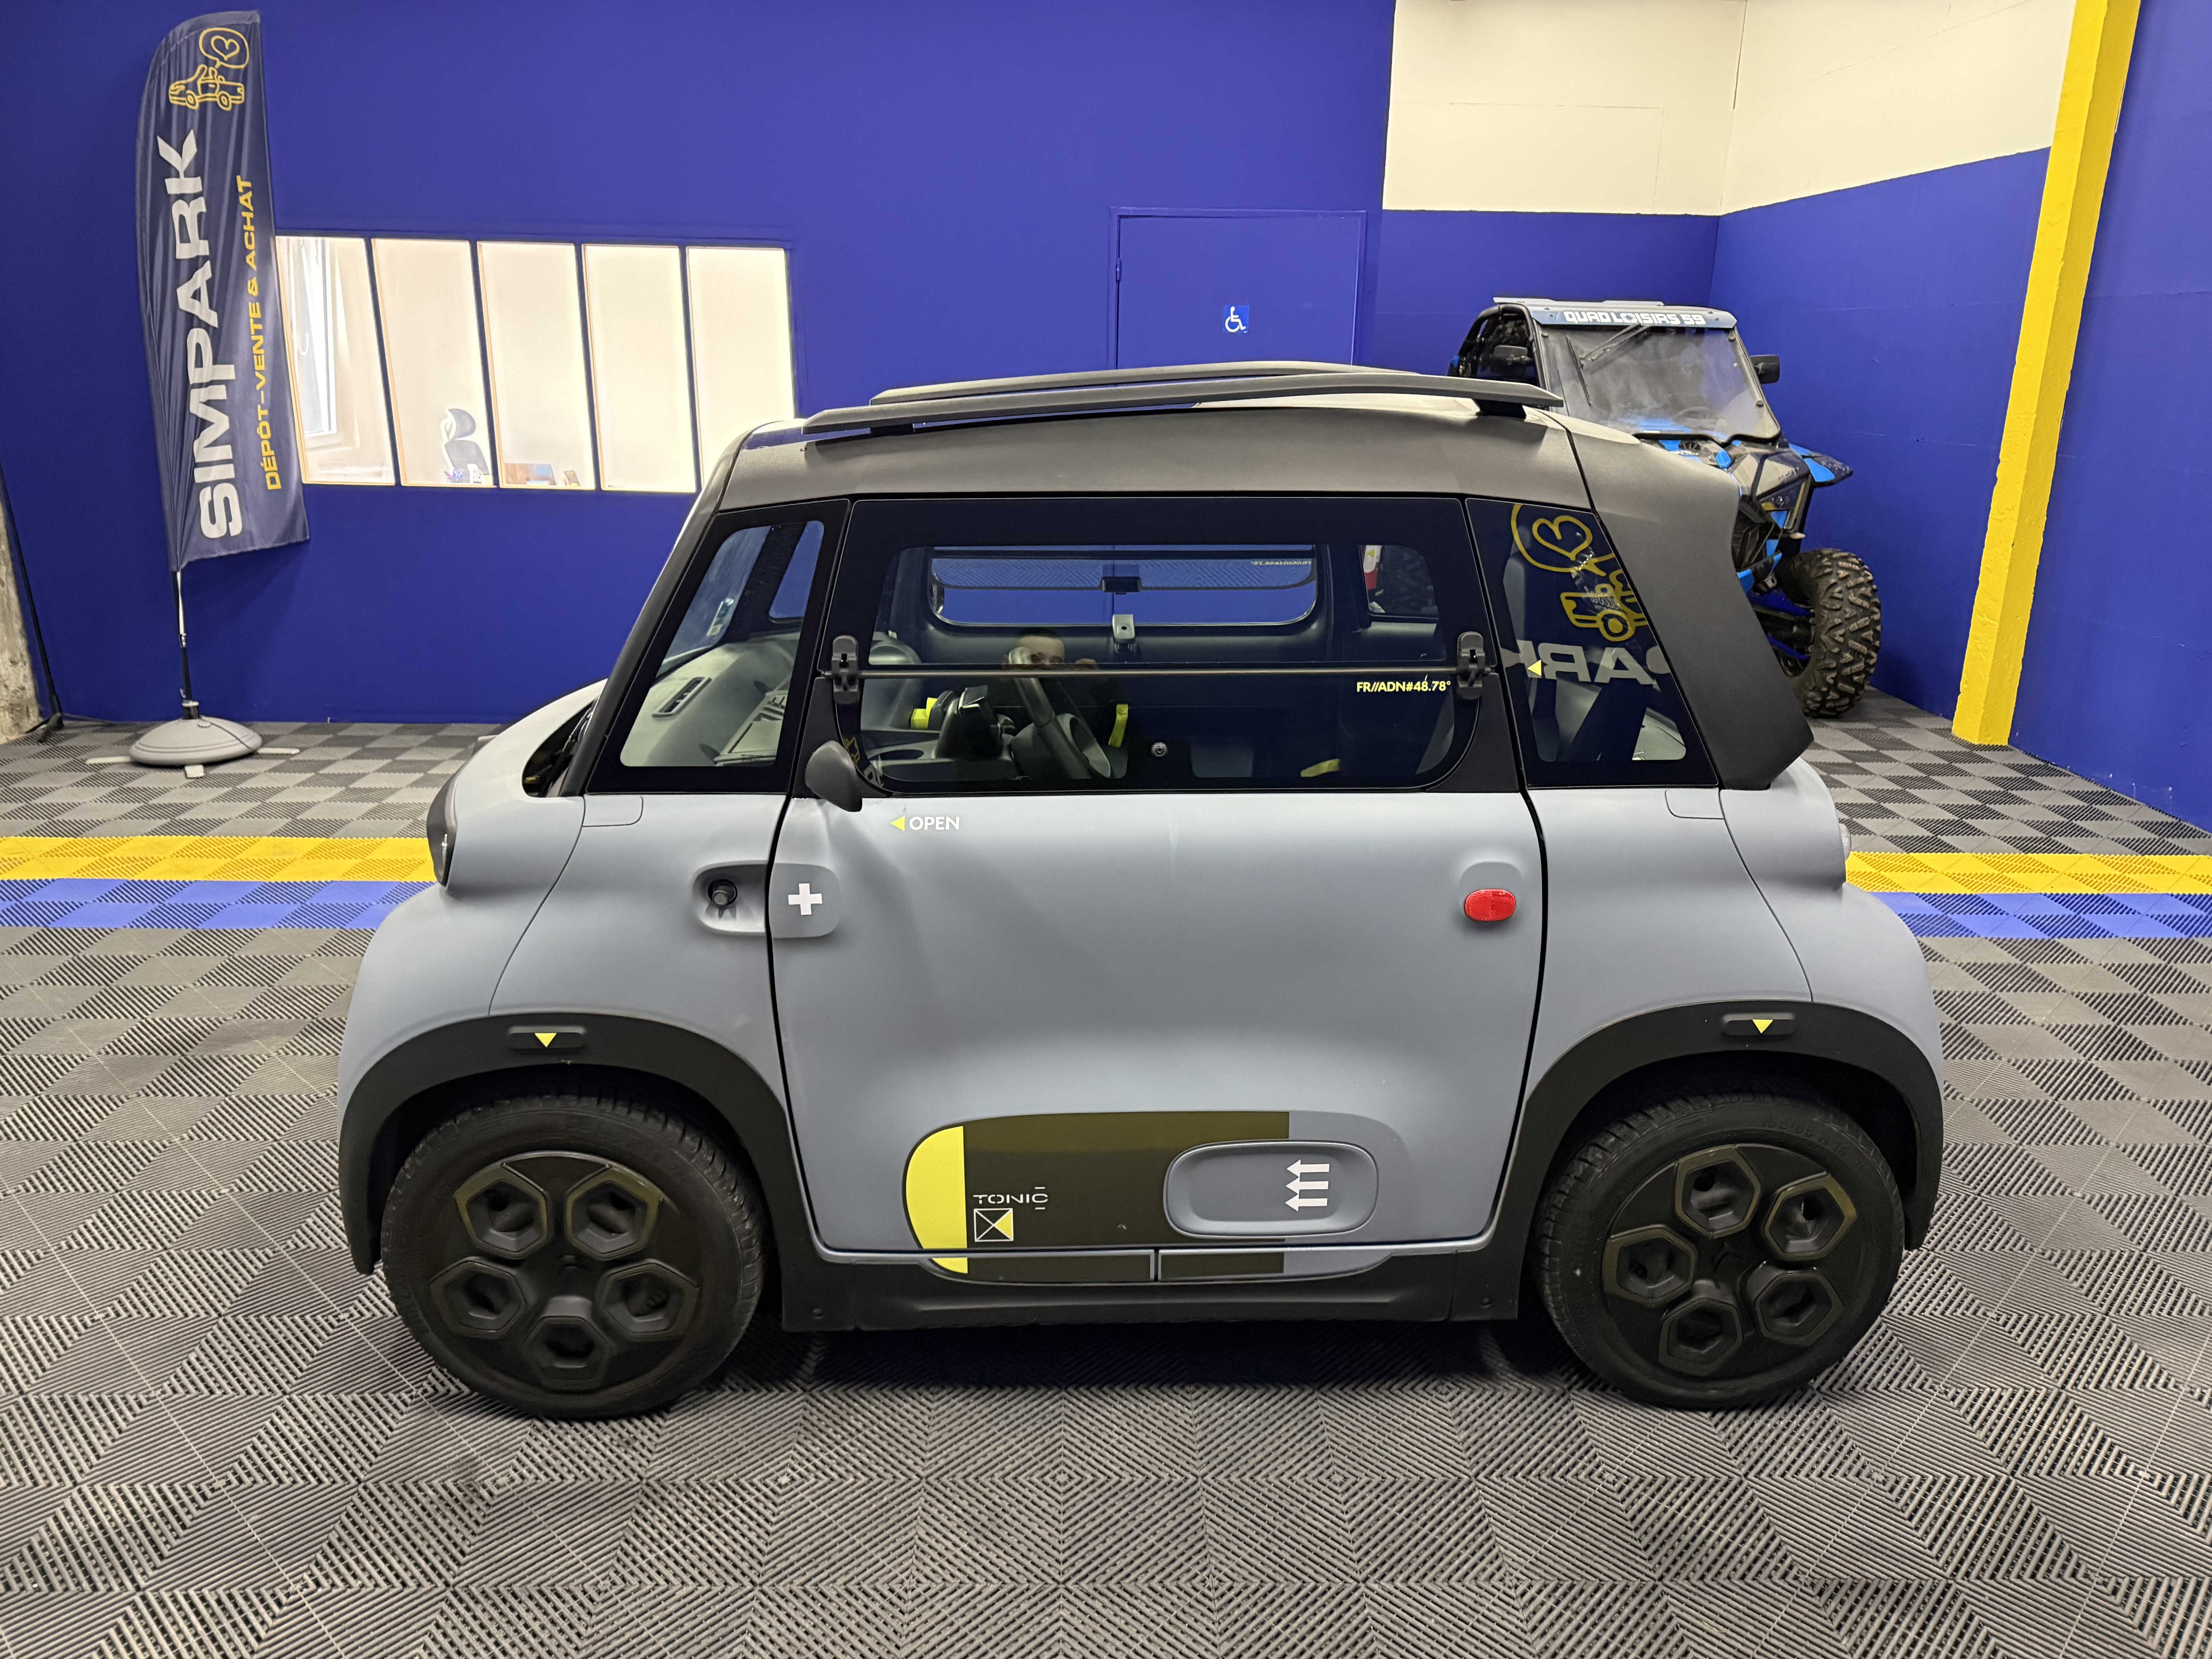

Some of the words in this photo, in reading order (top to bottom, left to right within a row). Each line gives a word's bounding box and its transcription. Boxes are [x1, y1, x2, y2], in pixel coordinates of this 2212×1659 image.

[236, 175, 256, 271] ACHAT
[248, 276, 258, 296] &
[1564, 311, 1611, 324] QUAD
[1610, 312, 1681, 325] LOISIRS
[1682, 314, 1706, 325] 59
[156, 129, 242, 539] SIMPARK
[249, 302, 282, 490] DÉPÔT-VENTE
[1357, 680, 1451, 692] FR//ADN#48.78°
[909, 816, 960, 830] OPEN
[973, 1187, 1048, 1210] TONIC
